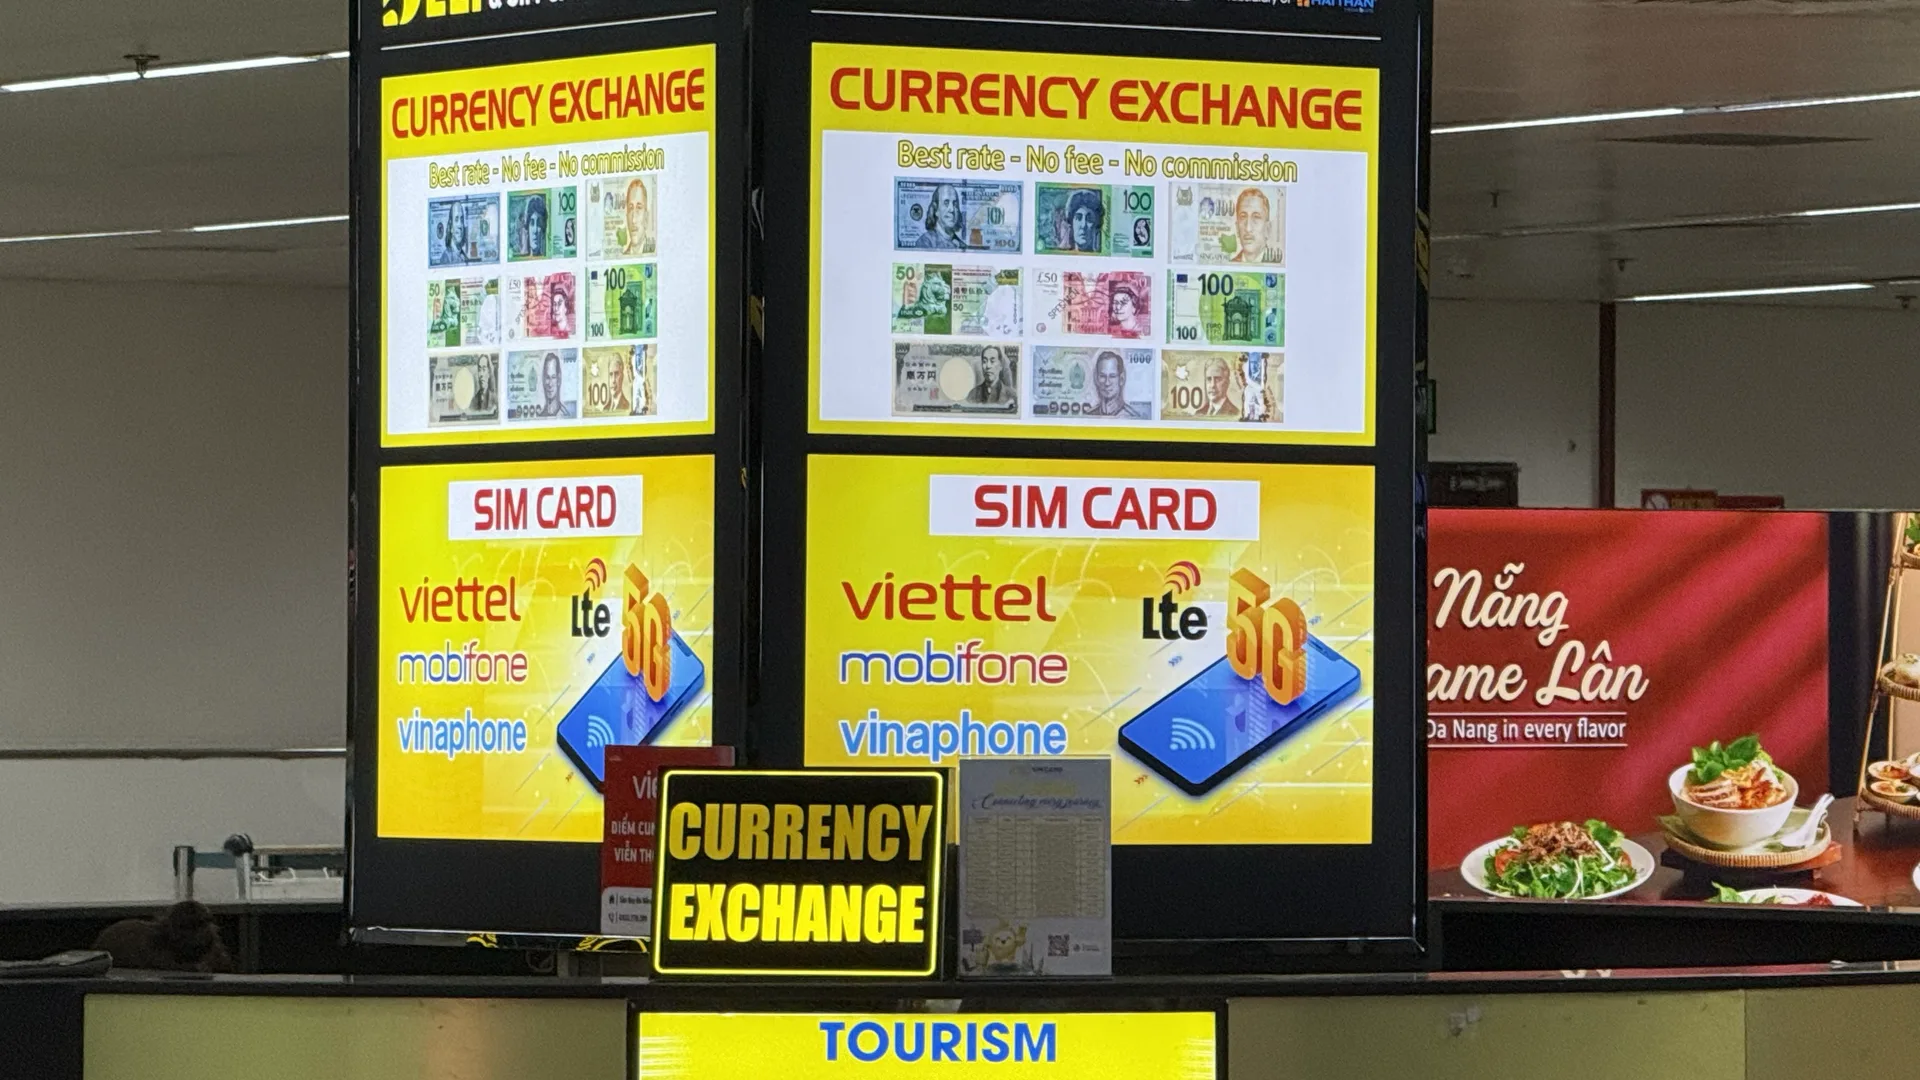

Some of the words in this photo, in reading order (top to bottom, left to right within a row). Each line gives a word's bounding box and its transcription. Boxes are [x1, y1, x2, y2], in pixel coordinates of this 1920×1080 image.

[392, 84, 544, 138] CURRENCY
[550, 68, 704, 123] EXCHANGE
[830, 67, 1099, 119] CURRENCY
[1110, 79, 1362, 131] EXCHANGE
[429, 161, 460, 189] Best
[461, 159, 490, 185] rate
[501, 156, 522, 183] No
[524, 153, 547, 180] fee
[558, 151, 578, 177] No
[581, 143, 665, 175] commission
[897, 140, 953, 170] Best
[955, 144, 1004, 171] rate
[1026, 144, 1059, 173] No
[1065, 145, 1103, 175] fee
[1124, 149, 1158, 178] No
[1162, 154, 1297, 182] commission
[558, 191, 576, 212] 100
[1123, 189, 1152, 211] 100
[429, 283, 440, 296] 50
[604, 268, 626, 291] 100
[895, 266, 915, 281] 50
[1036, 271, 1058, 283] £50
[1198, 273, 1234, 296] 100
[953, 303, 964, 312] 50
[591, 323, 604, 337] 100
[1176, 327, 1197, 340] 100
[588, 383, 608, 406] 100
[1171, 387, 1203, 409] 100
[474, 488, 528, 531] SIM
[536, 485, 617, 530] CARD
[974, 485, 1068, 529] SIM
[1082, 488, 1218, 531] CARD
[399, 576, 521, 623] viettel
[841, 572, 1057, 622] viettel
[1433, 562, 1569, 646] Nẵng
[622, 563, 672, 702] 5G
[1226, 567, 1307, 706] 5G
[398, 641, 528, 683] mobifone
[840, 640, 1068, 684] mobifone
[1427, 662, 1528, 701] ame
[1535, 639, 1650, 706] Lân
[398, 709, 527, 759] vinaphone
[840, 710, 1067, 762] vinaphone
[1453, 719, 1498, 743] Nang
[1503, 718, 1518, 738] in
[1524, 722, 1572, 742] every
[1577, 717, 1627, 738] flavor
[669, 802, 933, 861] CURRENCY
[669, 883, 925, 943] EXCHANGE
[819, 1021, 1057, 1062] TOURISM
